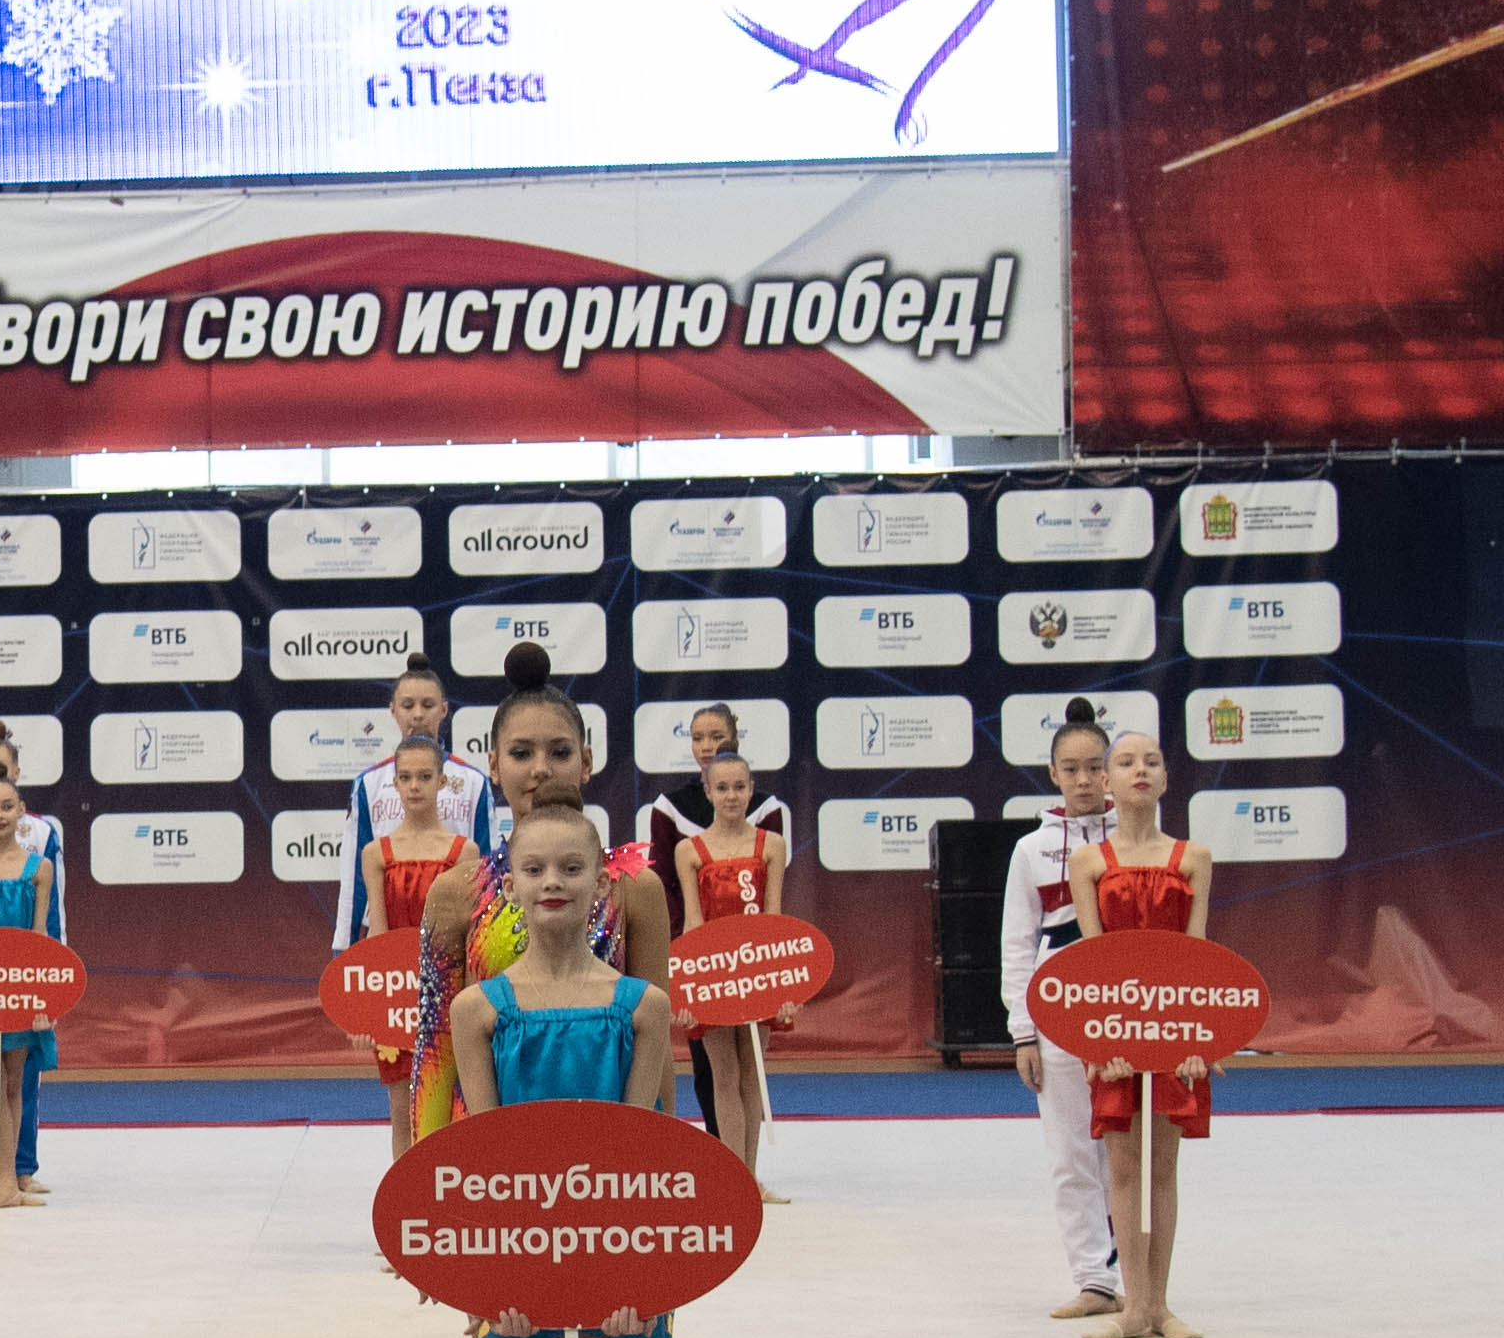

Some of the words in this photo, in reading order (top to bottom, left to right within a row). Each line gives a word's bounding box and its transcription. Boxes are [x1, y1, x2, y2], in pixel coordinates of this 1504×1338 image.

[395, 3, 510, 48] 2023
[182, 292, 382, 359] свою
[397, 281, 727, 369] историю
[744, 257, 1014, 357] побед!
[878, 612, 914, 629] ВТБ
[1247, 601, 1284, 618] ВТБ
[151, 628, 186, 645] ВТБ
[513, 621, 549, 638] ВТБ
[881, 815, 918, 832] ВТБ
[1253, 806, 1291, 823] ВТБ
[153, 829, 189, 846] ВТБ
[668, 936, 814, 979] Республика
[344, 965, 420, 997] Перм
[680, 965, 810, 1004] Татарстан
[1039, 977, 1260, 1011] Оренбургская
[387, 1007, 420, 1034] кр
[1084, 1014, 1214, 1042] область
[435, 1164, 696, 1209] Республика
[401, 1219, 734, 1263] Башкортостан
